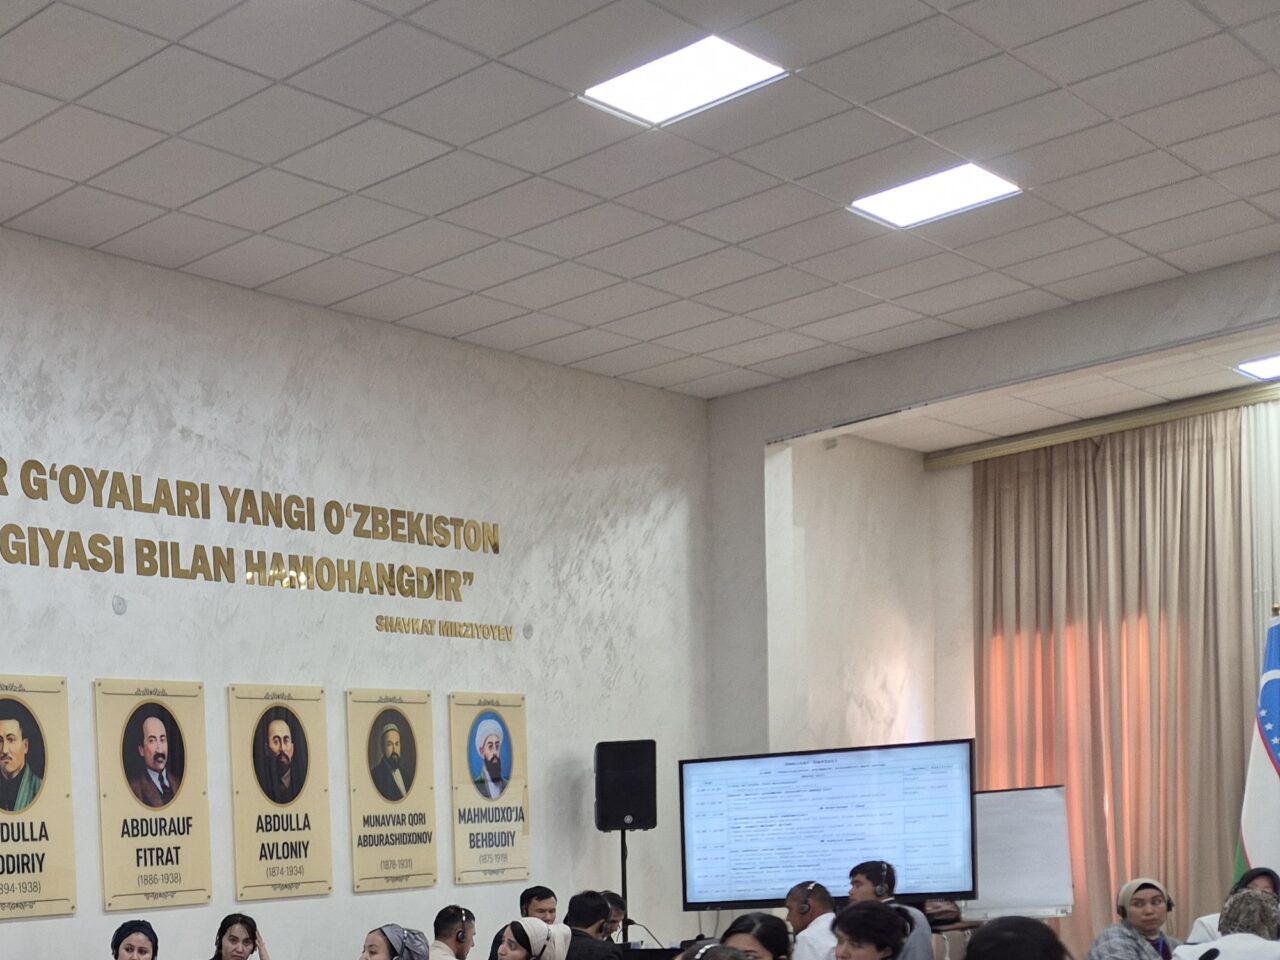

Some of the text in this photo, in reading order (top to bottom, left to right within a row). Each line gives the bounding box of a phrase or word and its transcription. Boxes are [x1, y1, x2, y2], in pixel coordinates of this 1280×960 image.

[219, 484, 316, 531] YANGI
[134, 539, 237, 584] BILAN
[375, 614, 515, 642] SHAVKAT MIRZIYOYEV
[120, 818, 193, 839] ABDURAUF
[255, 813, 312, 834] ABDULLA
[362, 813, 426, 829] MUNAVVAR QORI
[357, 831, 433, 848] ABDURASHIDXONOV
[469, 830, 516, 849] BEHBUDIY
[136, 846, 181, 867] FITRAT
[258, 840, 310, 862] AVLONIY
[137, 871, 182, 886] (1886-1938)
[266, 864, 305, 879] (1874-1934)
